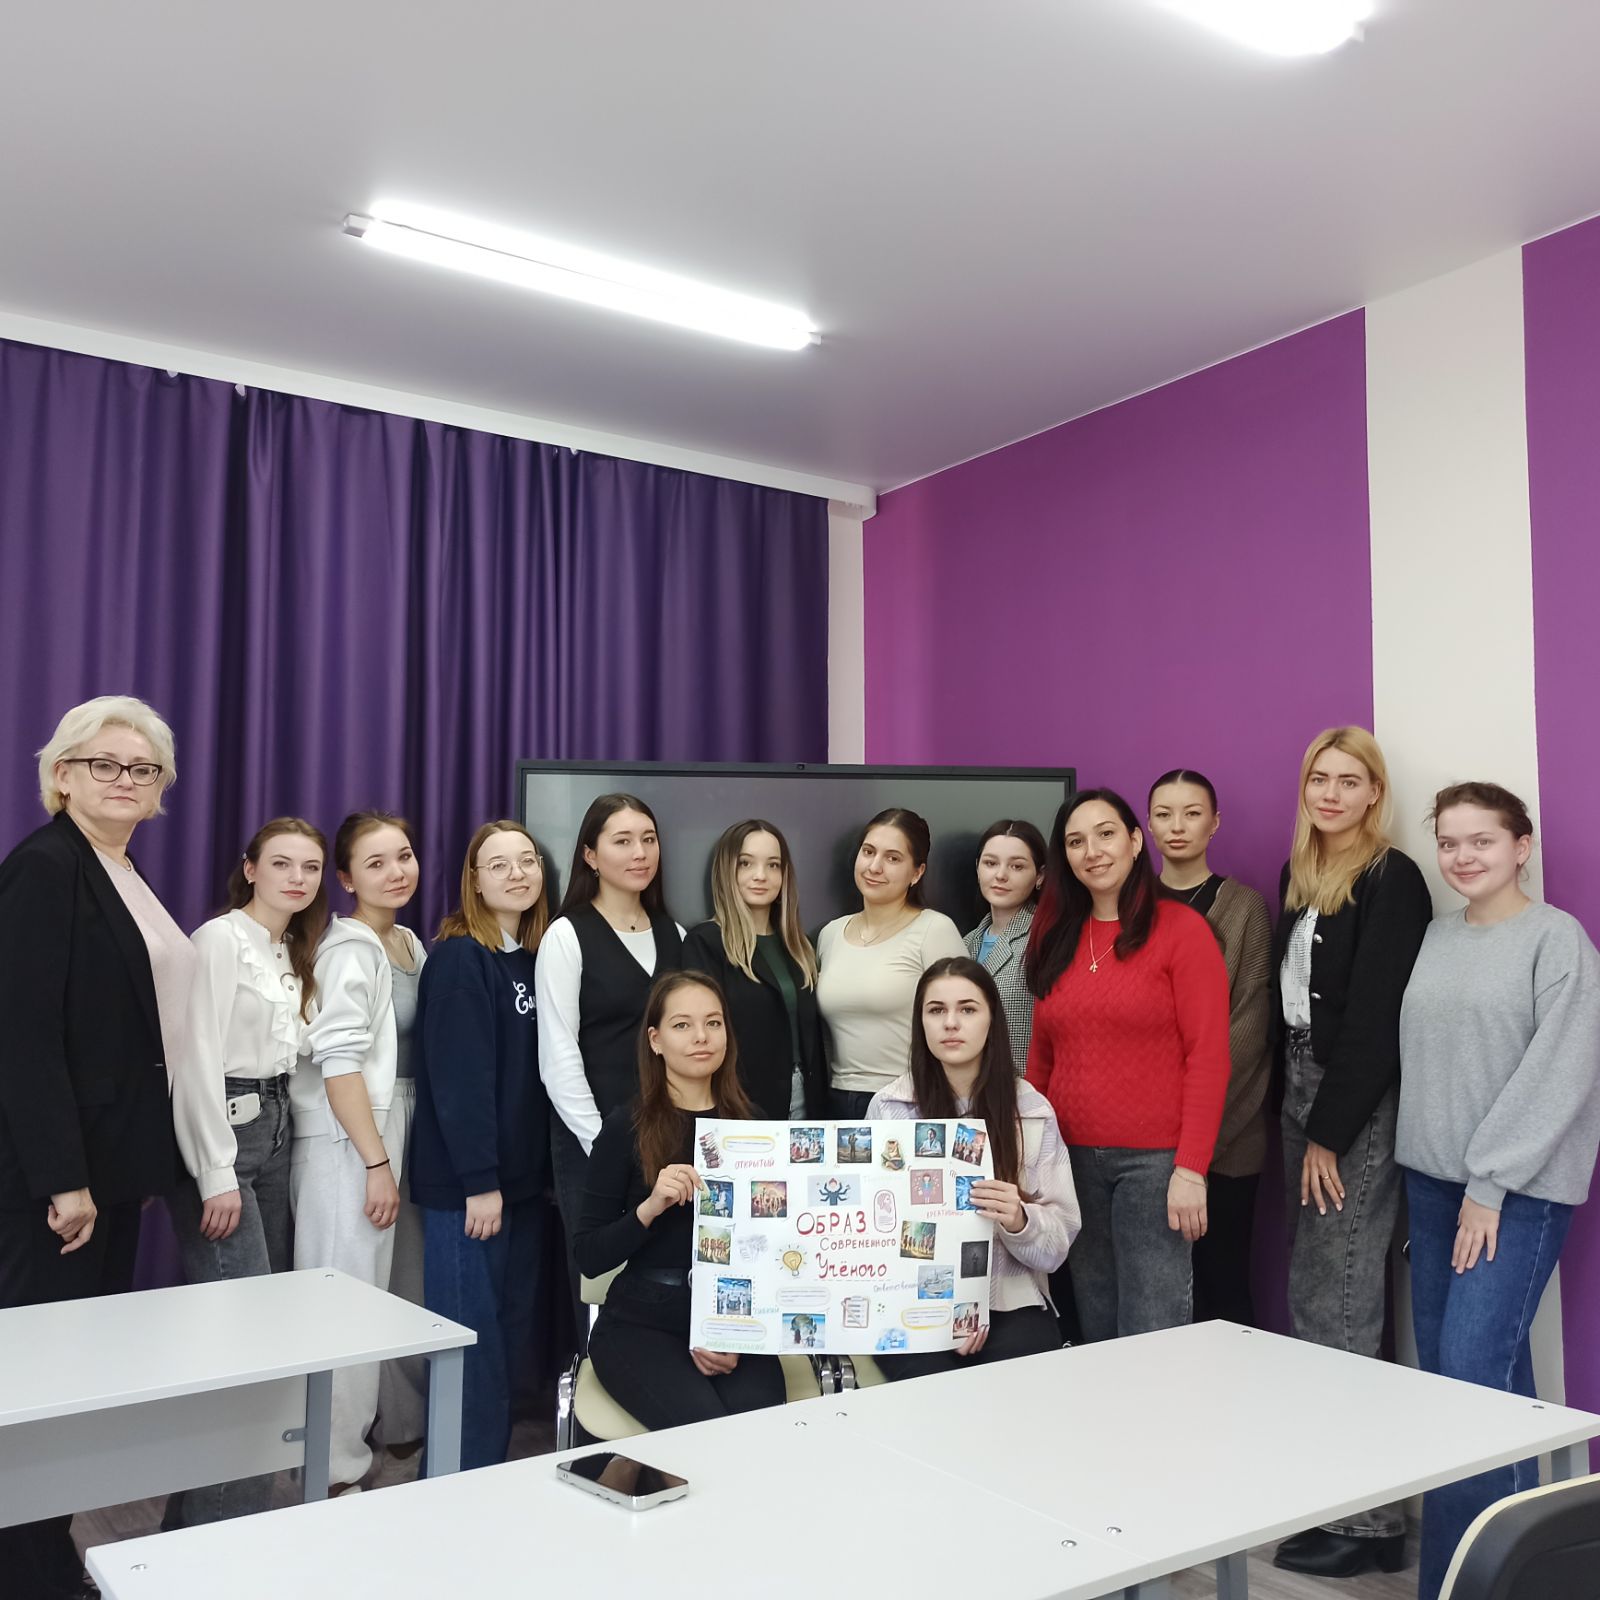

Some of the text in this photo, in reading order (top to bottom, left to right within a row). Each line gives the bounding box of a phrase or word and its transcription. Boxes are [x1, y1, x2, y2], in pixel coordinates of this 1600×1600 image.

[734, 1158, 775, 1170] ОТКРЫТЫЙ
[796, 1210, 866, 1235] ОБРАЗ
[816, 1252, 887, 1279] Учёного
